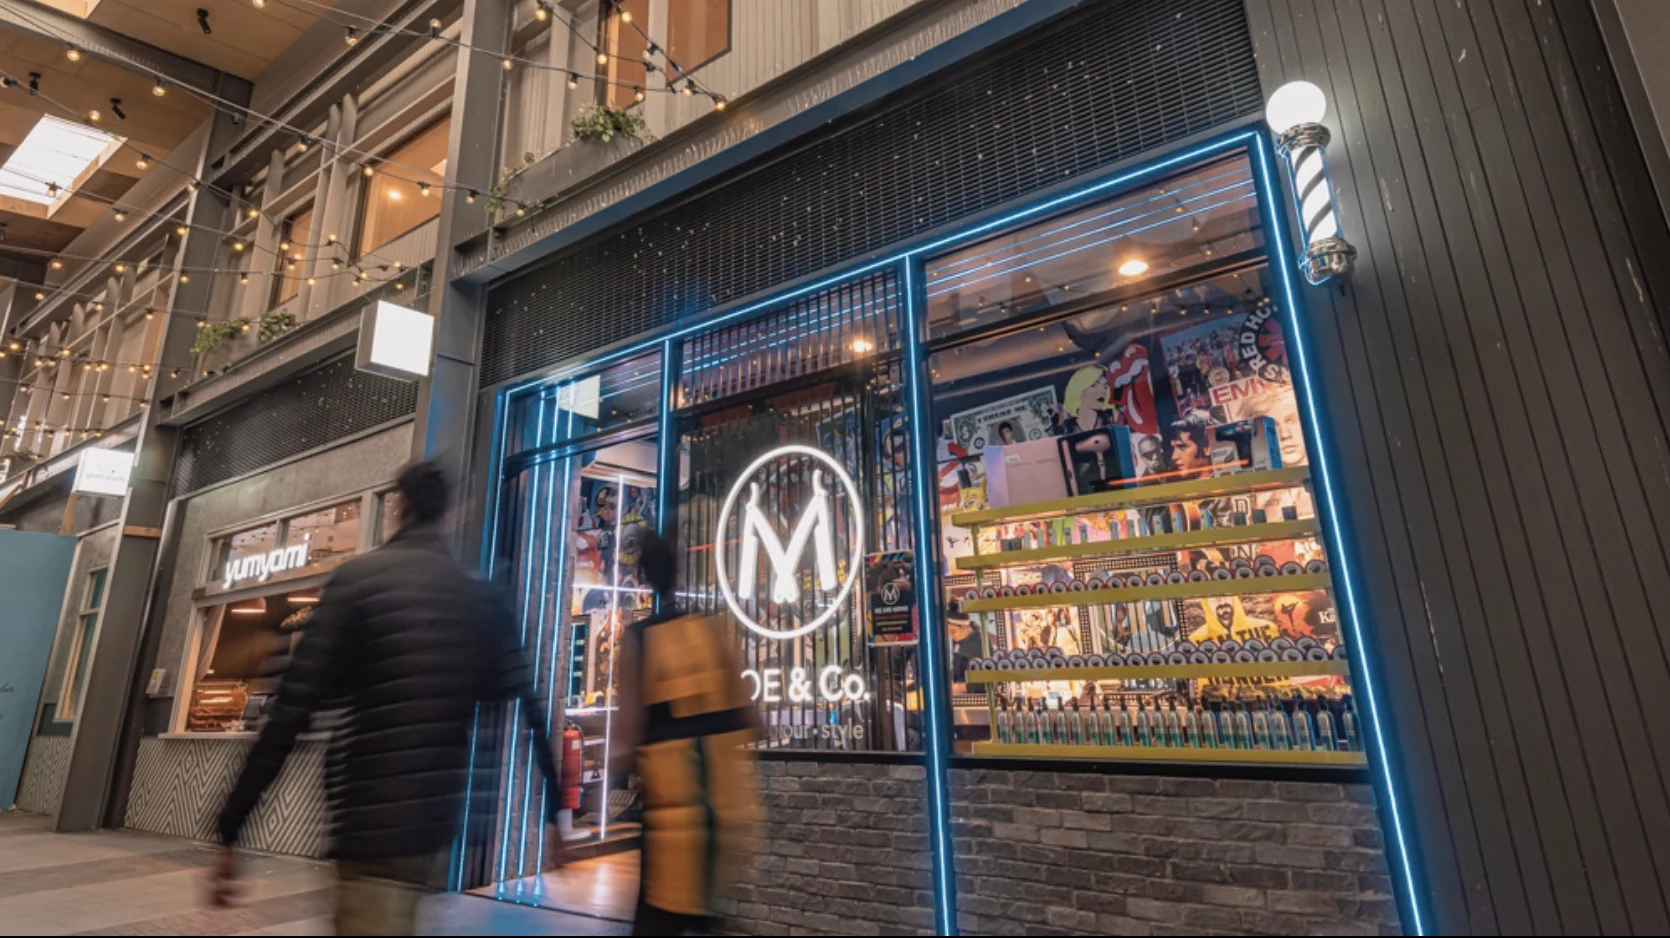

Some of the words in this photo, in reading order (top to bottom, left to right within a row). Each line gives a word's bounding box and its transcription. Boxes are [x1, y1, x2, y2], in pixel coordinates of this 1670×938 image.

[739, 469, 837, 604] M
[740, 668, 783, 702] OE
[788, 666, 814, 702] &
[818, 664, 871, 702] Co.
[821, 718, 865, 746] style
